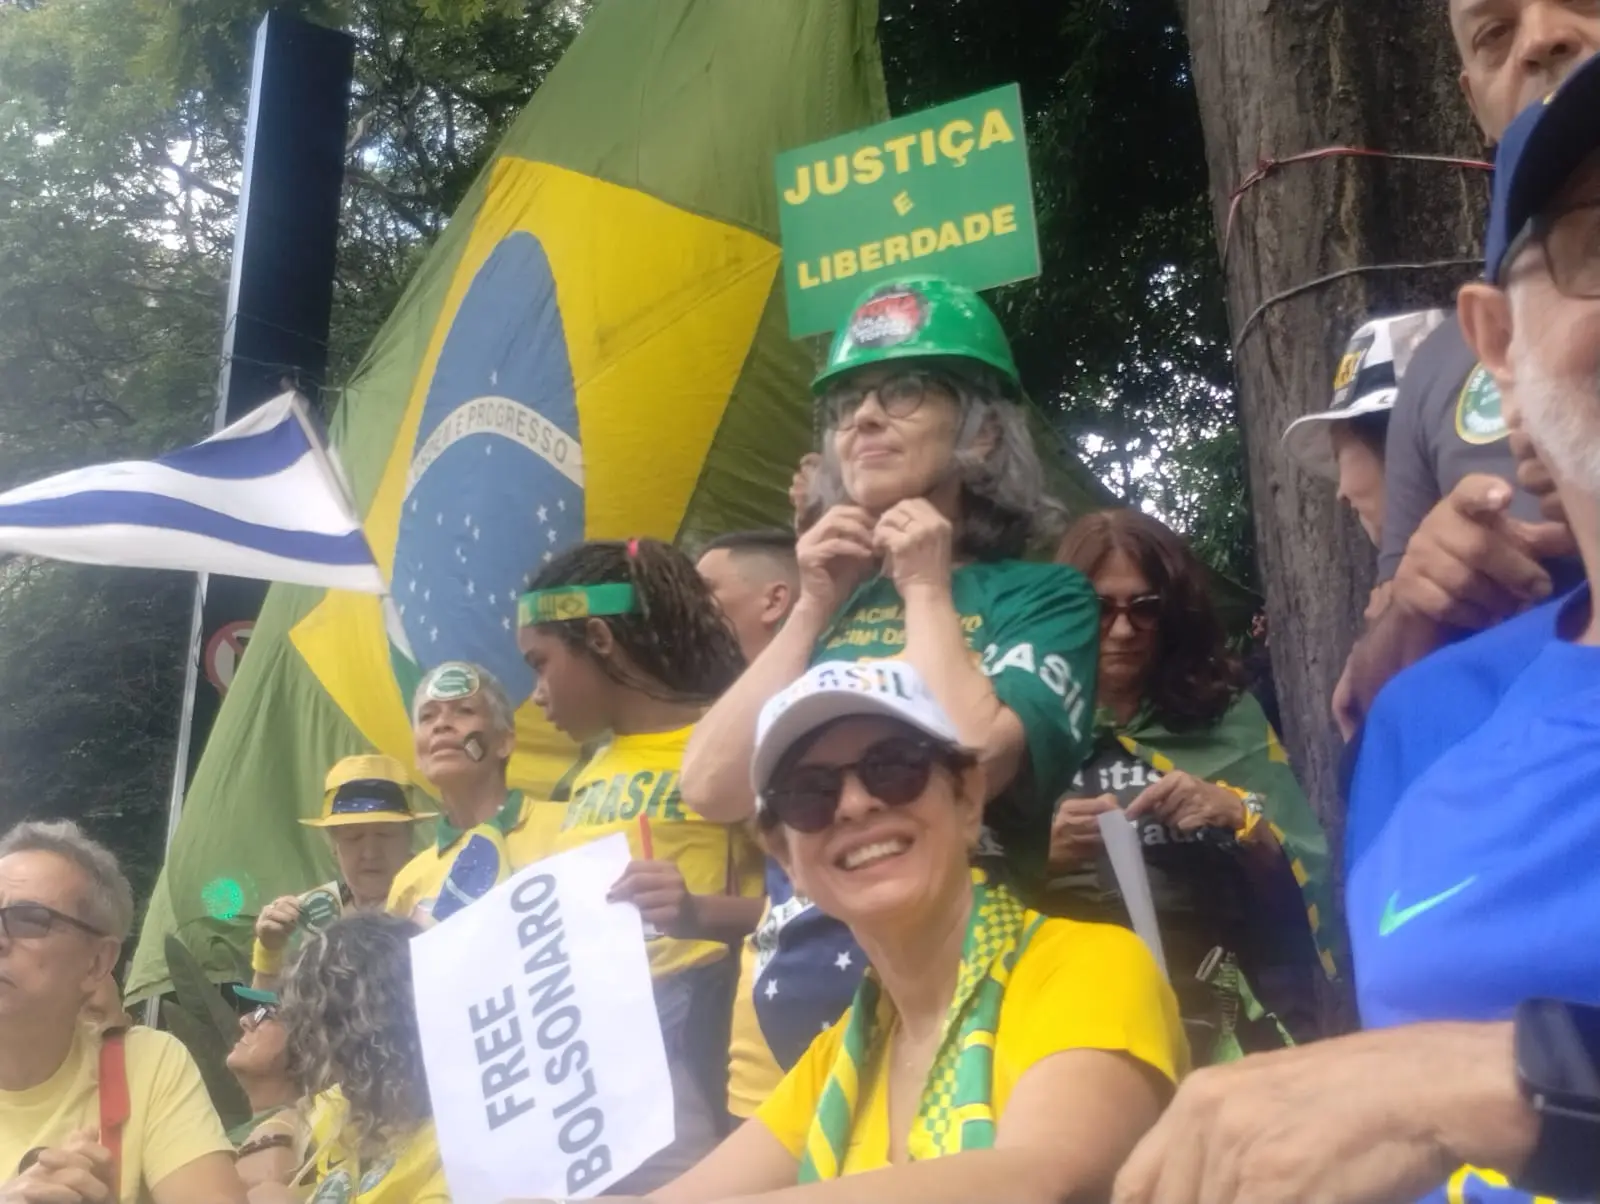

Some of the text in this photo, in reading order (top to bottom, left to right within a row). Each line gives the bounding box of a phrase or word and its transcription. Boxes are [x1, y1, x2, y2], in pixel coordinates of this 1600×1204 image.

[783, 108, 1016, 204] JUSTIÇA
[797, 204, 1017, 288] LIBERDADE
[467, 402, 568, 464] PROGRESSO
[468, 984, 536, 1131] FREE
[510, 873, 613, 1197] BOLSONARO
